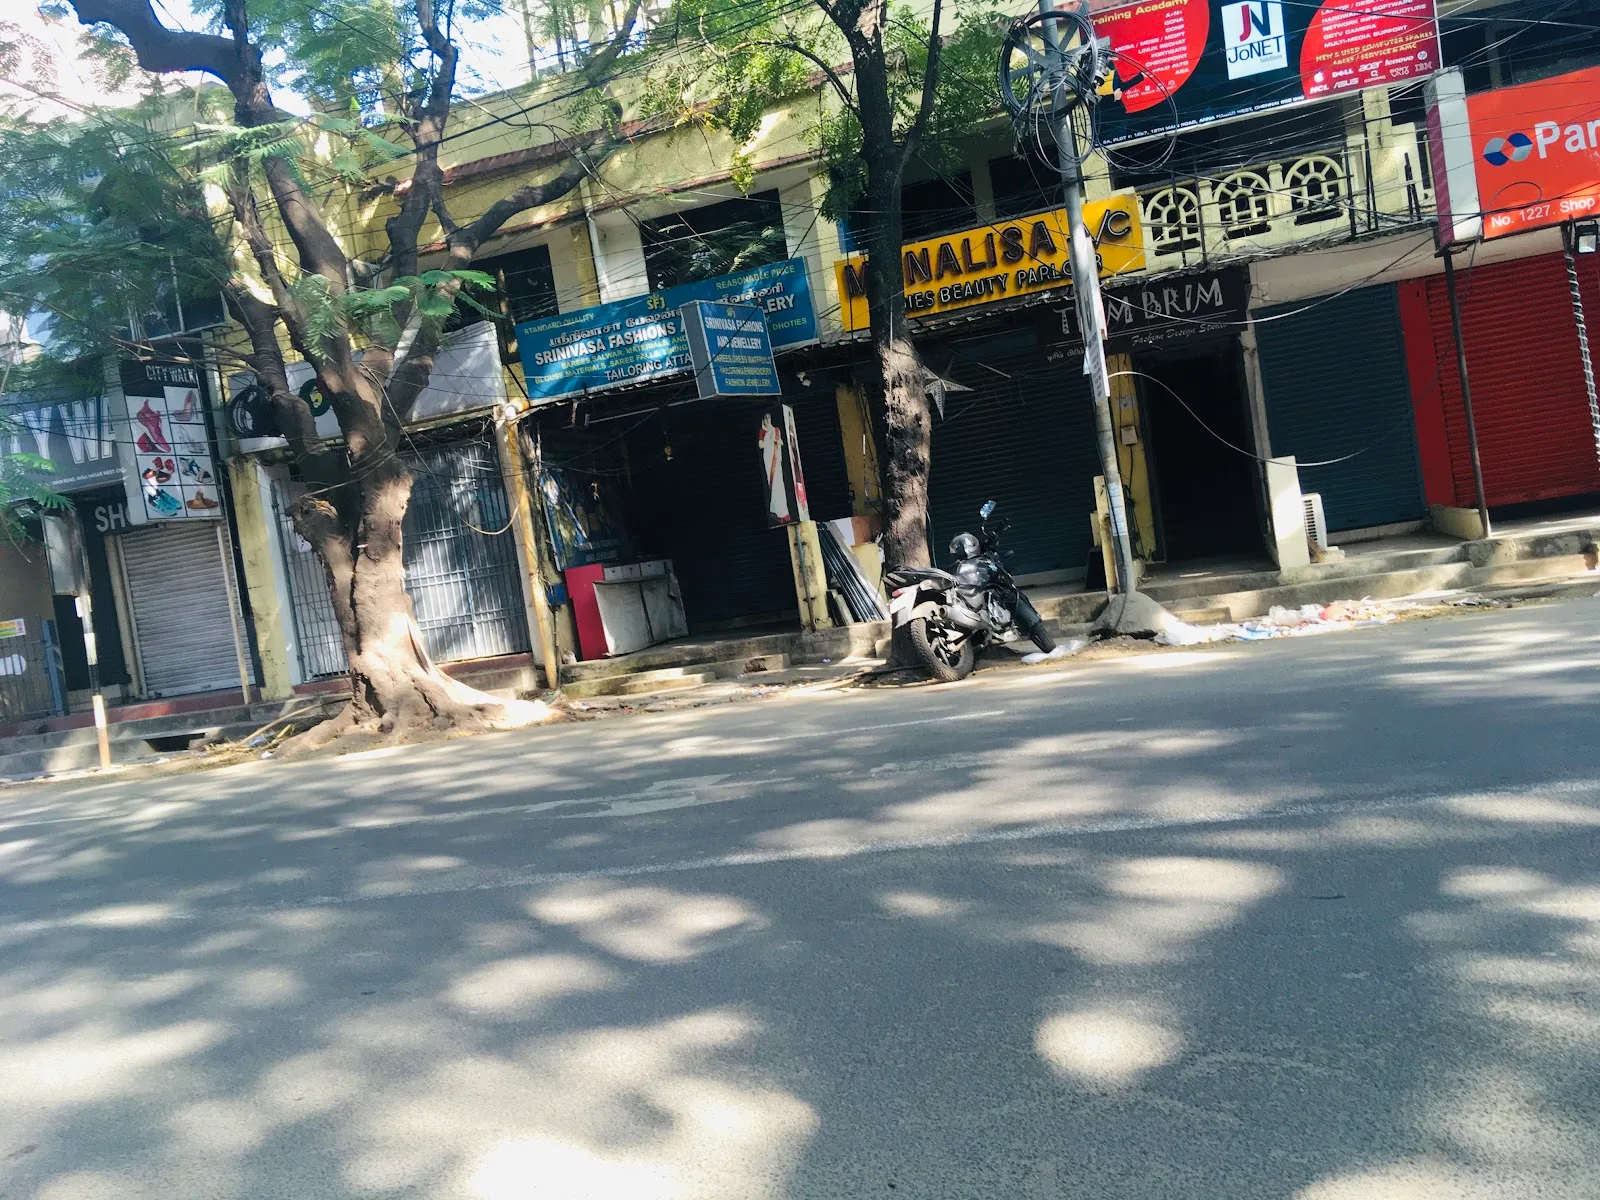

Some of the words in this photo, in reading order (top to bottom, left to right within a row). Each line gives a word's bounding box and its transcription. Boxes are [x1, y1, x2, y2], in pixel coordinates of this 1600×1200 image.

[1322, 19, 1358, 31] NETWORK
[1373, 25, 1408, 37] SUPPORT
[1491, 215, 1514, 228] No.
[1560, 197, 1596, 214] Shop
[843, 220, 1058, 298] MNALISA
[716, 273, 770, 291] REASONABLE
[771, 264, 796, 278] PRICE
[940, 272, 1009, 304] BEAUTY
[1142, 277, 1224, 320] BRIM
[524, 320, 562, 336] STANDARD
[772, 317, 808, 331] DHOTIES
[535, 337, 607, 366] SRINIVASA
[608, 321, 677, 350] FASHIONS
[604, 360, 663, 382] TAILORING
